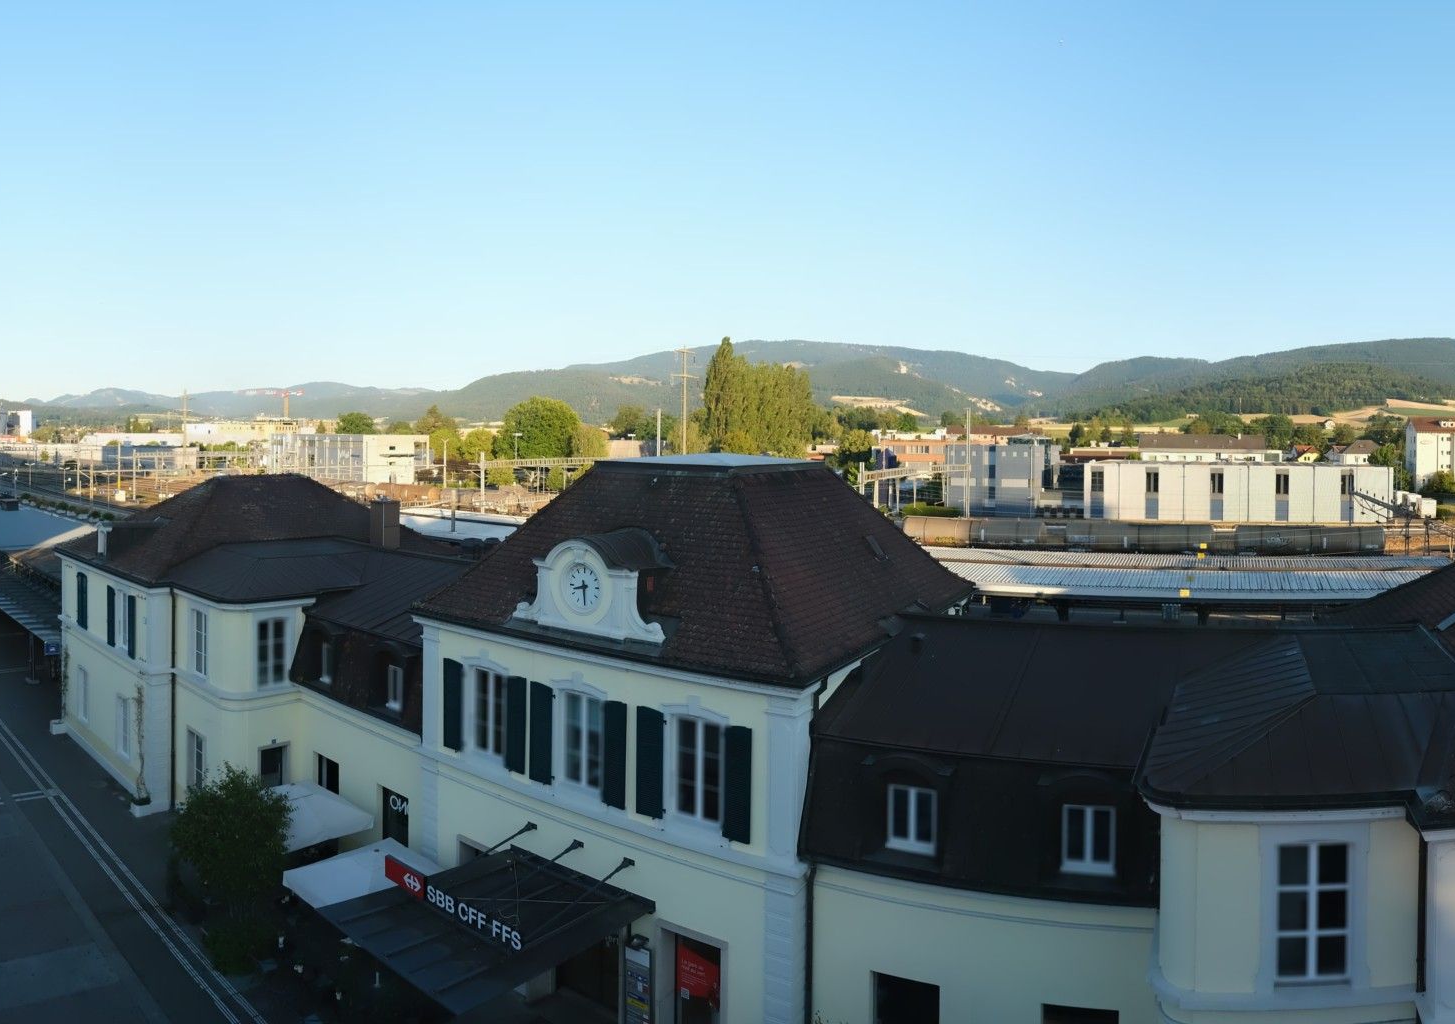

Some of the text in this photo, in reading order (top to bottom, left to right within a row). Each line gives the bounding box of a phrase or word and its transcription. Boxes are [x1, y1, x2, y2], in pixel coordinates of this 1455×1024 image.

[426, 885, 522, 951] SBB CFF FFS
